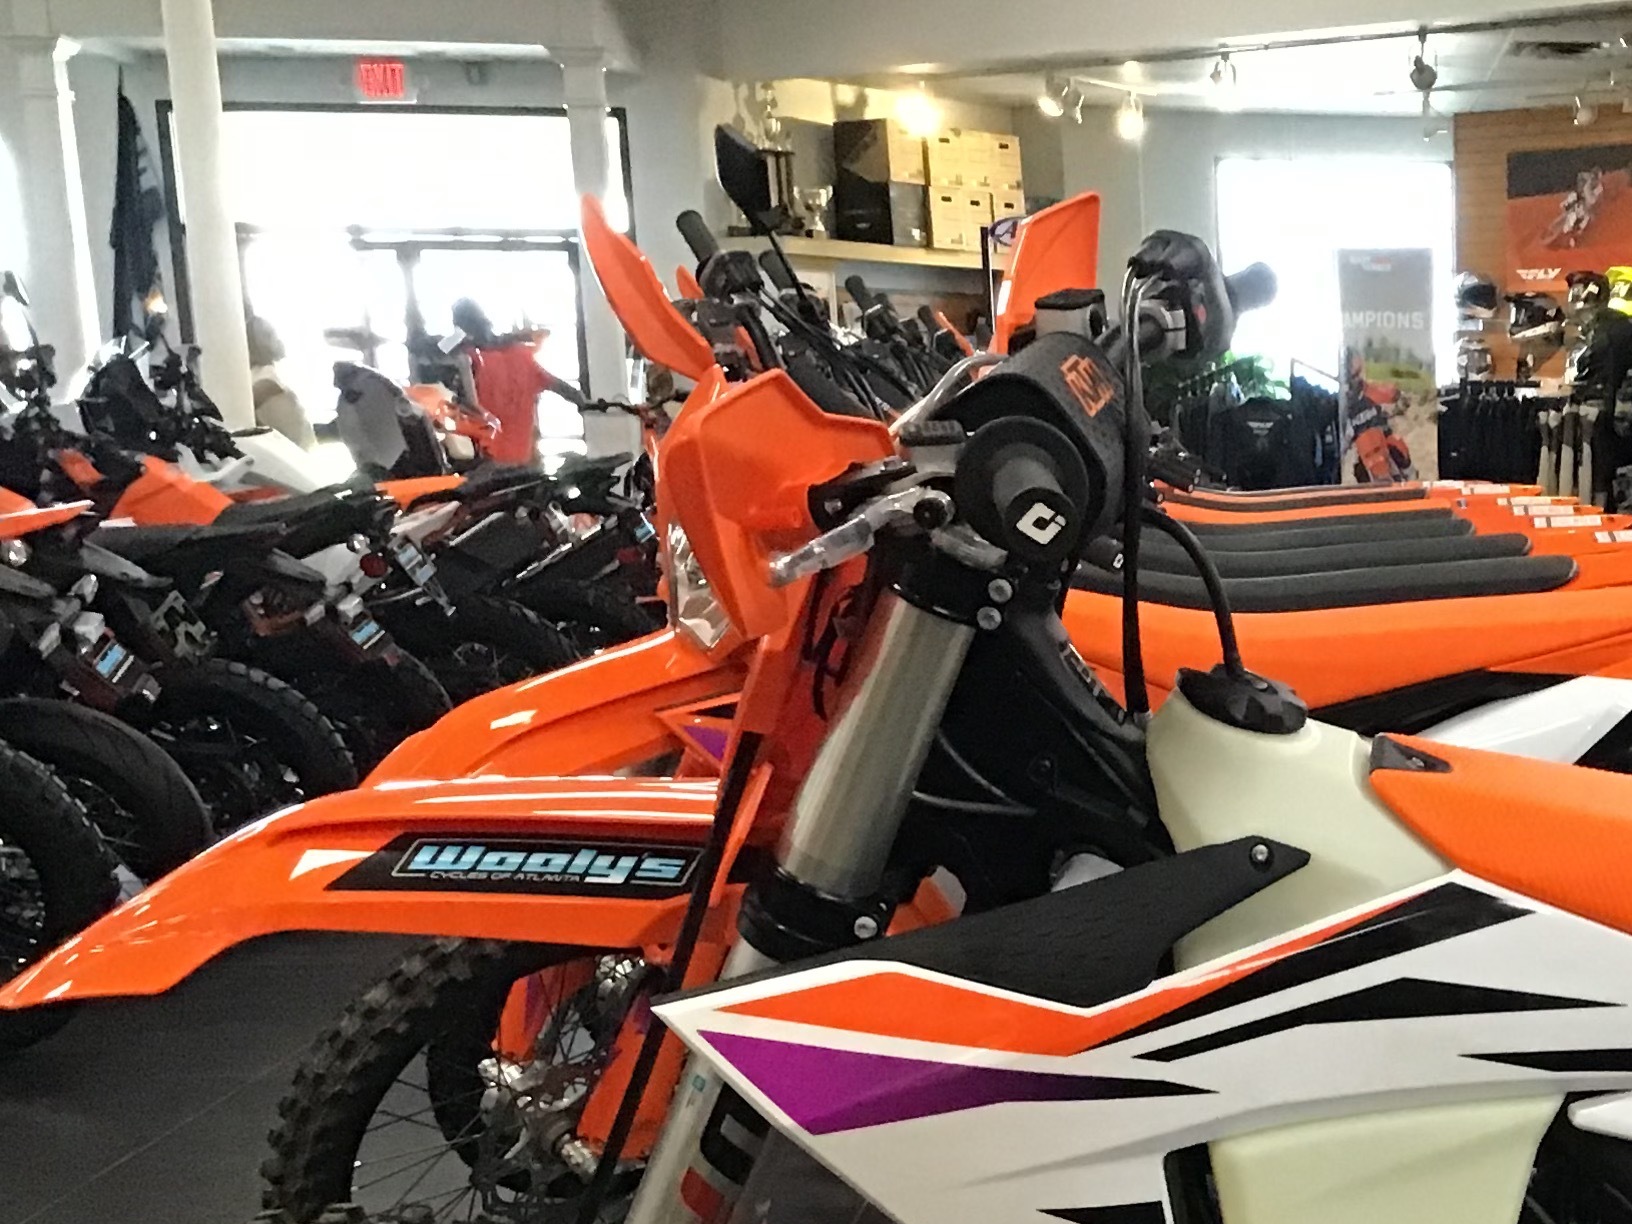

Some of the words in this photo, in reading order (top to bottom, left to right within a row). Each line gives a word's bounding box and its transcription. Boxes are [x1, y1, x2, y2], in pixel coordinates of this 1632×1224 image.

[1343, 310, 1424, 330] AMPIONS
[430, 871, 488, 880] CYCLES
[490, 872, 511, 880] OF
[513, 873, 580, 882] ATLANTA
